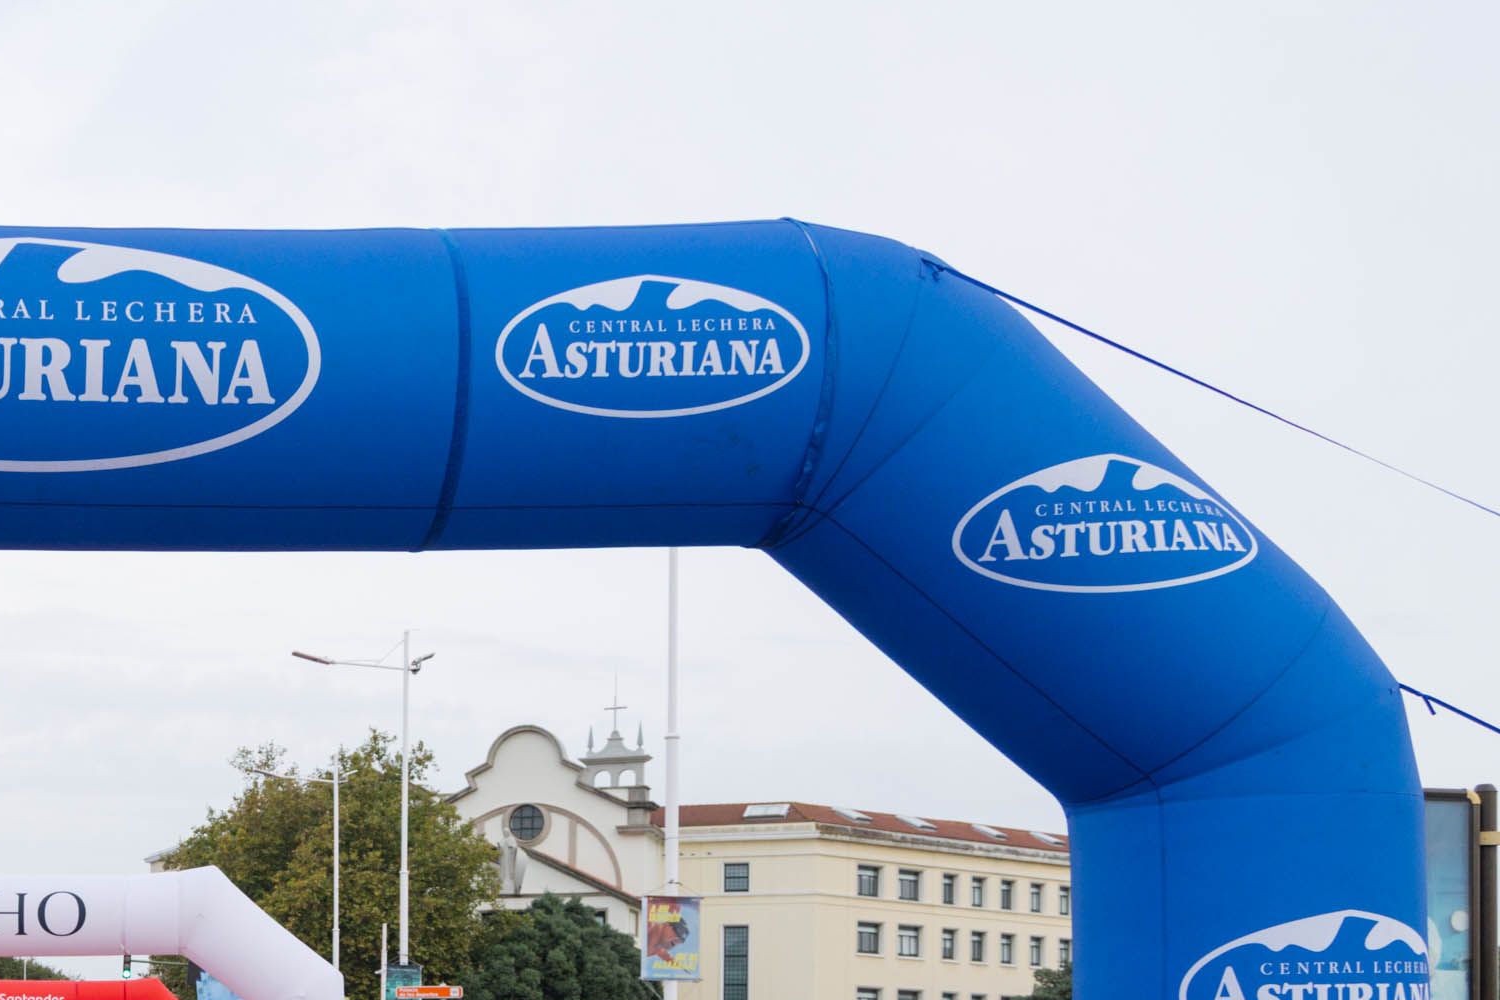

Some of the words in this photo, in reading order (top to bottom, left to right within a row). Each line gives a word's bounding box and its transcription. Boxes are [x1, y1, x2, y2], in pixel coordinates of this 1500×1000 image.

[74, 300, 258, 325] LECHERA
[568, 318, 667, 334] CENTRAL
[676, 317, 777, 332] LECHERA
[519, 322, 784, 378] ASTURIANA
[1035, 501, 1135, 518] CENTRAL
[1144, 500, 1222, 517] LECHERA
[979, 508, 1247, 561] ASTURIANA
[1260, 961, 1362, 976] CENTRAL
